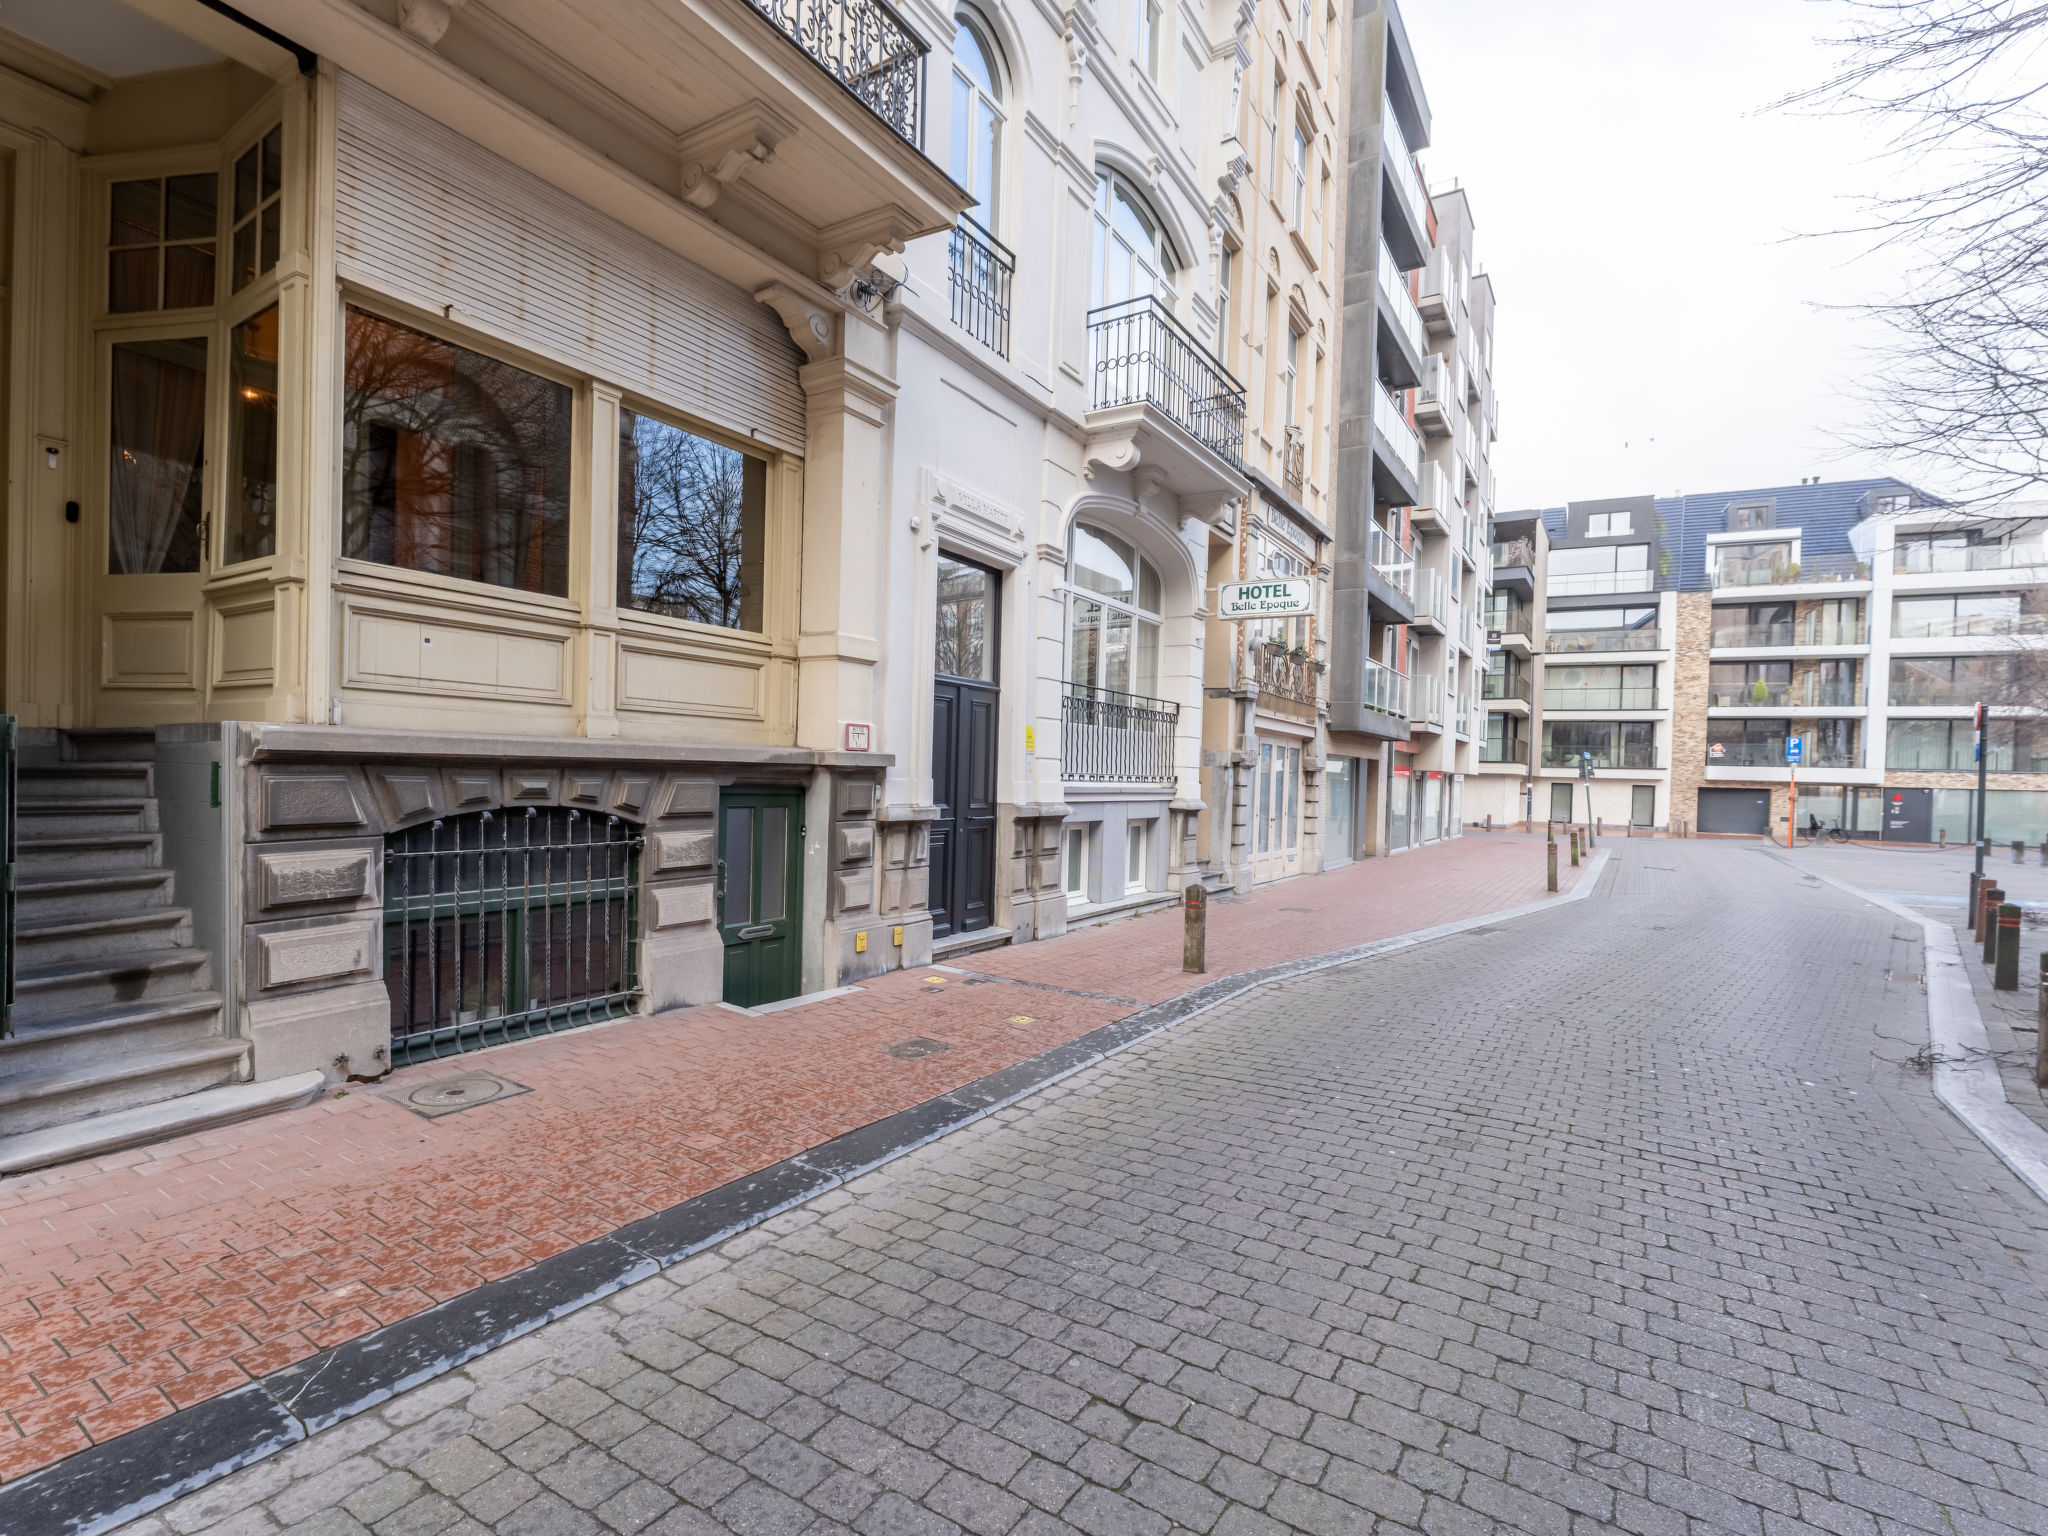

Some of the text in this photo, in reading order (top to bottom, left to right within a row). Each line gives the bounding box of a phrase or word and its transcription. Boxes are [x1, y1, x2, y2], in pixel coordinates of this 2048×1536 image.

[1271, 508, 1286, 531] Belle
[1238, 584, 1291, 600] HOTEL
[1231, 600, 1300, 612] Belle Epoque
[1790, 738, 1799, 748] P
